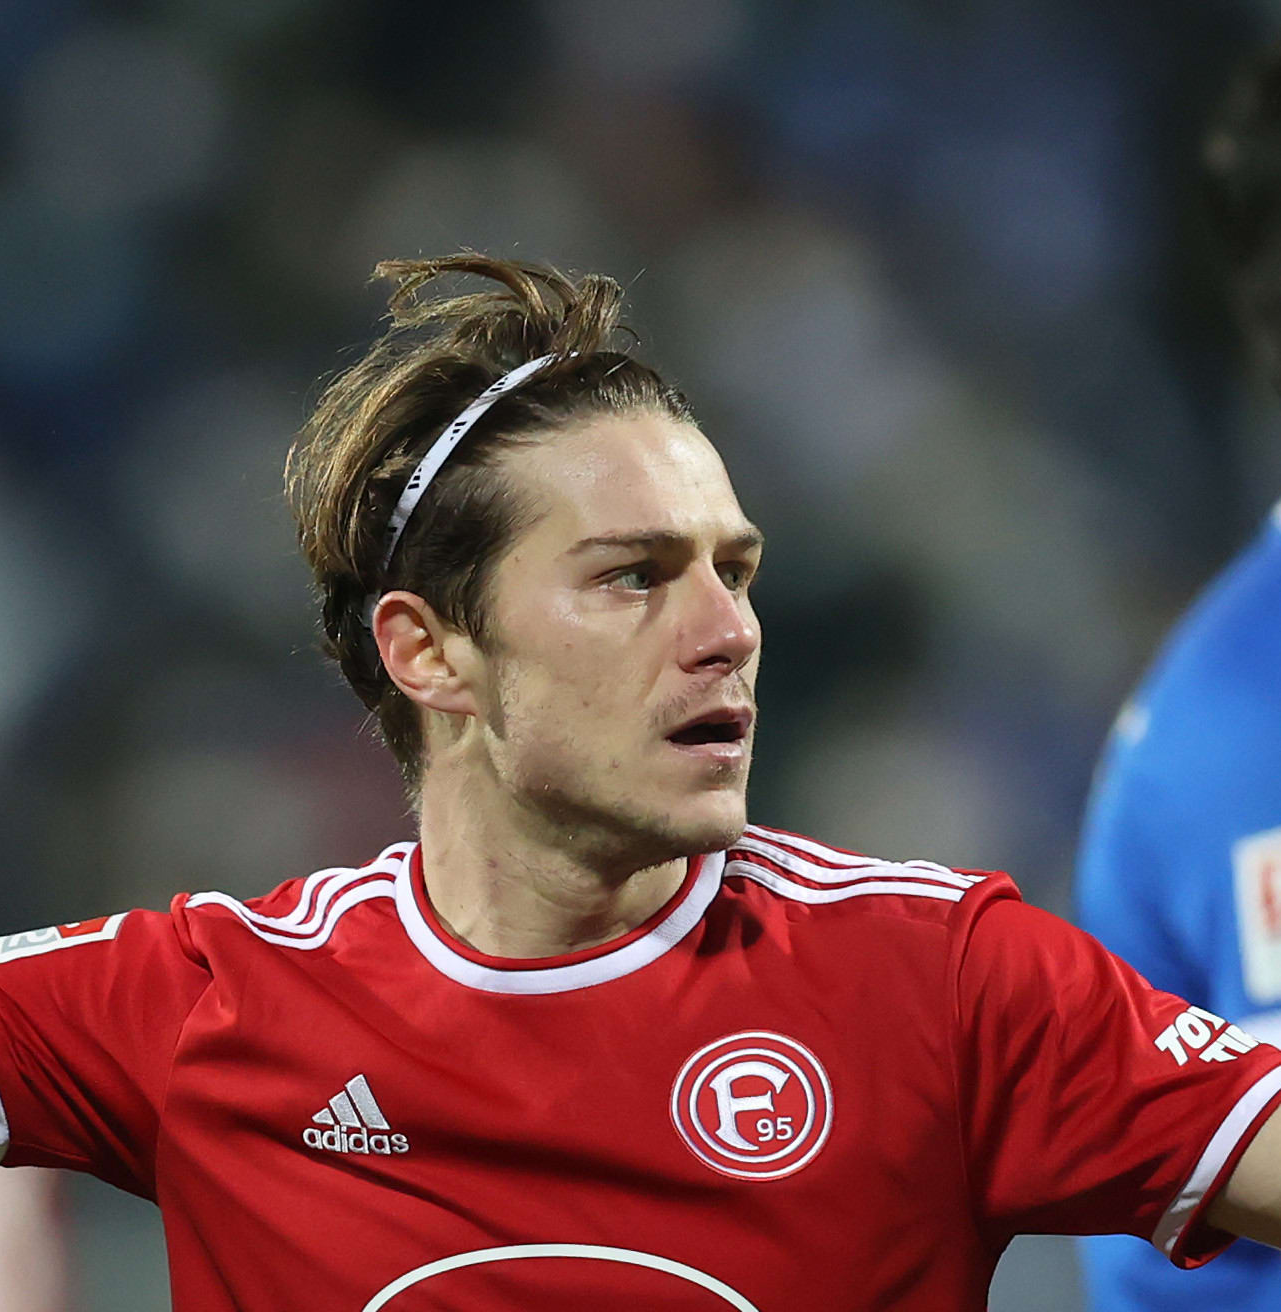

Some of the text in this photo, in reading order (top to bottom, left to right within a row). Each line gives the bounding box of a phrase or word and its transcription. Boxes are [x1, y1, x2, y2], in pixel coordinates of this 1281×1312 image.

[709, 1061, 794, 1151] F 95
[302, 1124, 410, 1155] adidas
